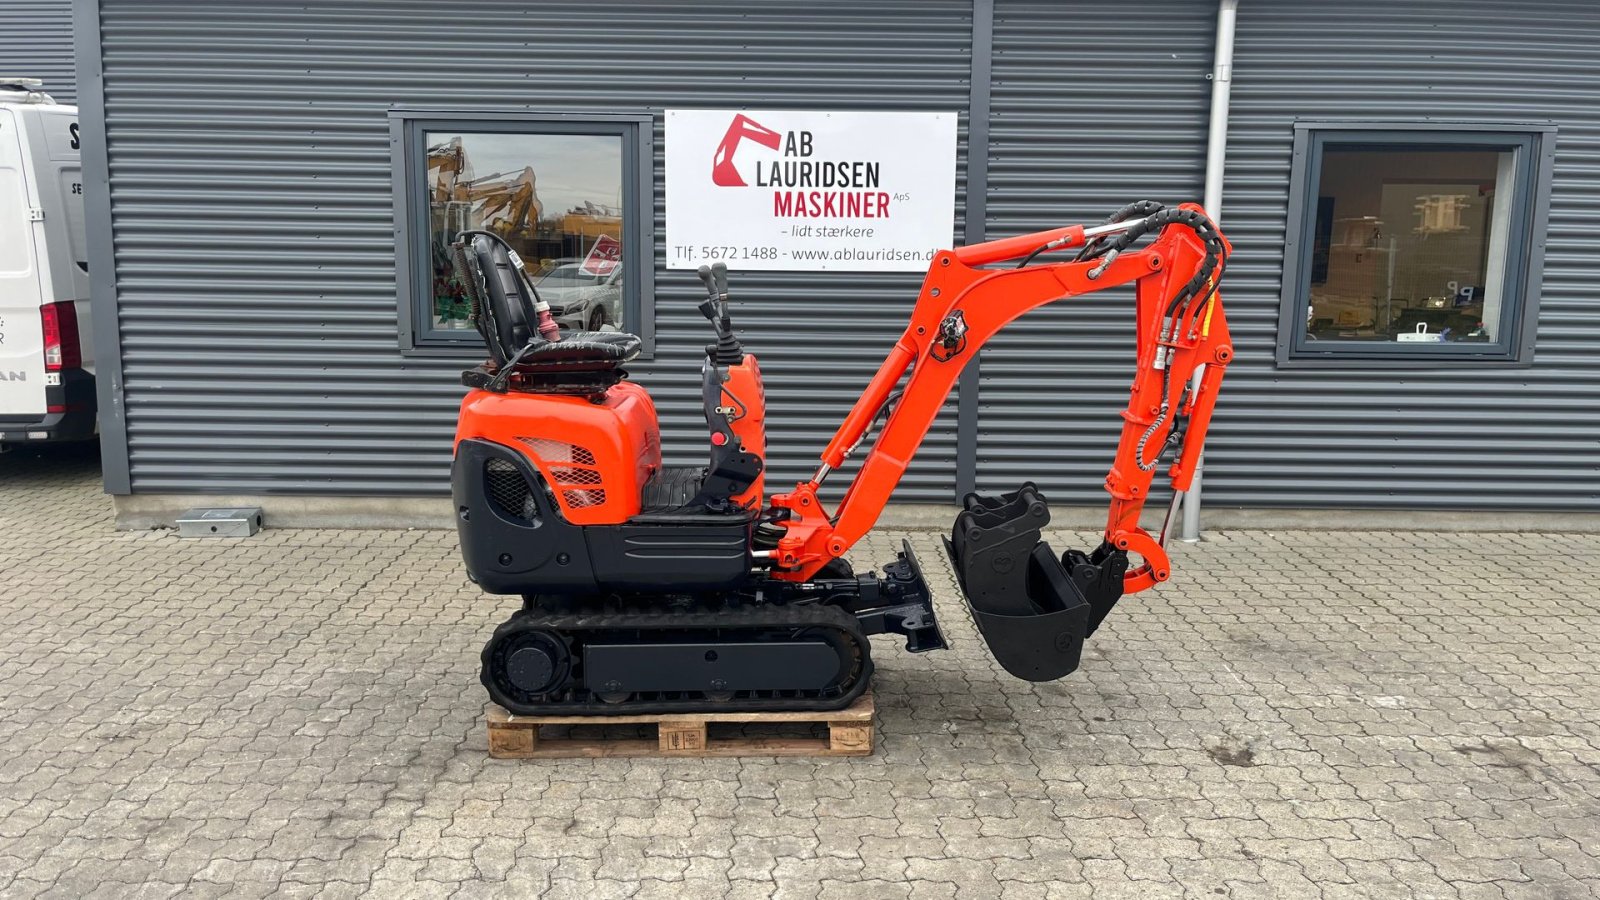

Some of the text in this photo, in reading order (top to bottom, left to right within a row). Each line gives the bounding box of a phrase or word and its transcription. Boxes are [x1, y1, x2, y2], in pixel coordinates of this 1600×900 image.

[784, 130, 813, 157] AB
[756, 161, 880, 188] LAURIDSEN
[774, 191, 910, 218] MASKINER ApS
[791, 225, 812, 238] lidt
[815, 225, 875, 238] stærkere
[675, 246, 698, 261] Tlf.
[702, 246, 738, 260] 5672
[742, 247, 778, 260] 1488
[791, 248, 940, 262] www.ablauridsen.d
